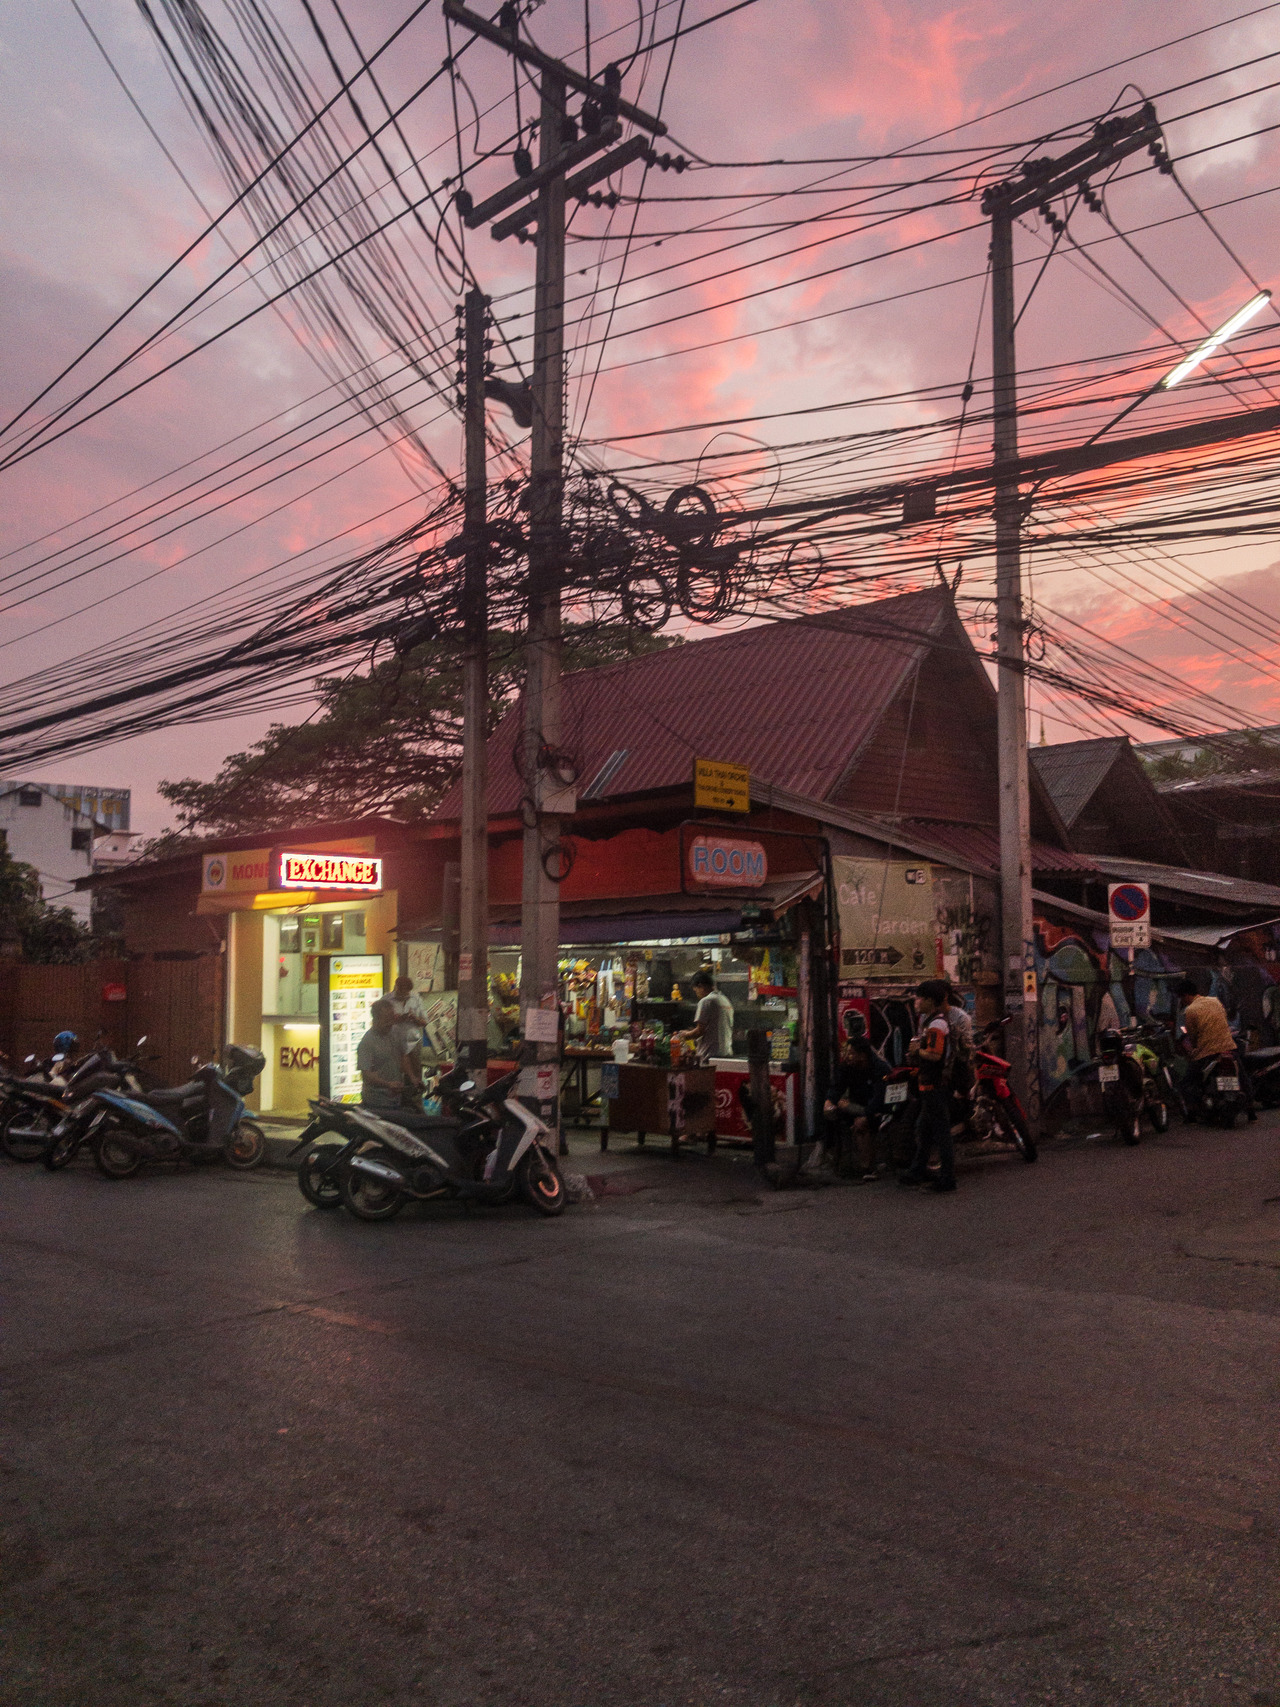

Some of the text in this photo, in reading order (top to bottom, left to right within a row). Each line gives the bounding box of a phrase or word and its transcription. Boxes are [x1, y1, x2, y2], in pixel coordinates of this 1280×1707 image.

[288, 858, 374, 883] EXCHANGE
[694, 846, 764, 876] ROOM
[871, 914, 928, 935] Garden
[279, 1047, 320, 1070] EXCH
